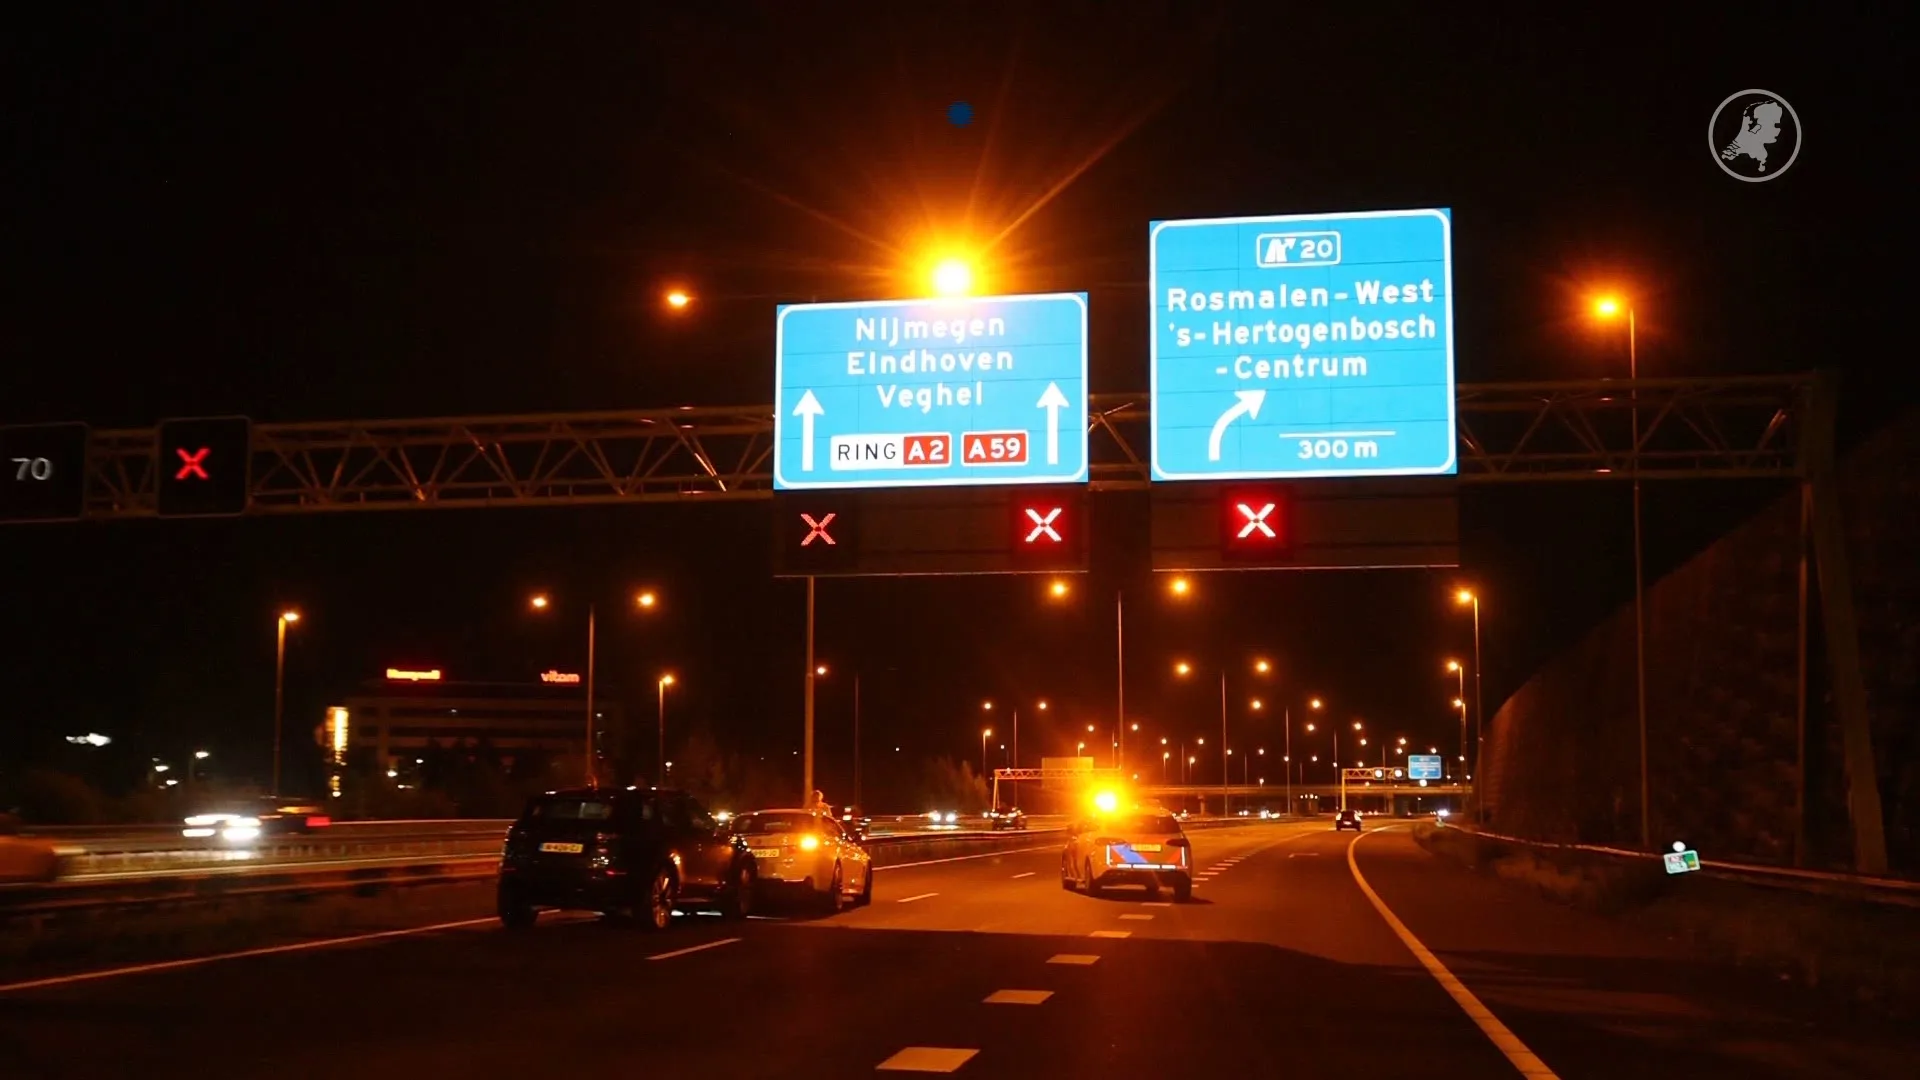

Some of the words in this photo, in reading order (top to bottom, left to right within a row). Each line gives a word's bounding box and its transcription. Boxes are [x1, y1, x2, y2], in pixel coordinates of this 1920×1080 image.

[1299, 239, 1334, 259] 20
[855, 317, 1004, 347] Nijmegen
[1168, 314, 1436, 349] 's-Hertogenbosch
[847, 349, 1013, 375] Eindhoven
[1216, 354, 1367, 380] -Centrum
[876, 381, 983, 414] Veghel
[837, 442, 897, 461] RING
[907, 439, 945, 461] A2
[968, 437, 1021, 459] A59
[1297, 439, 1349, 459] 300
[1354, 440, 1378, 458] m
[11, 457, 53, 481] 70
